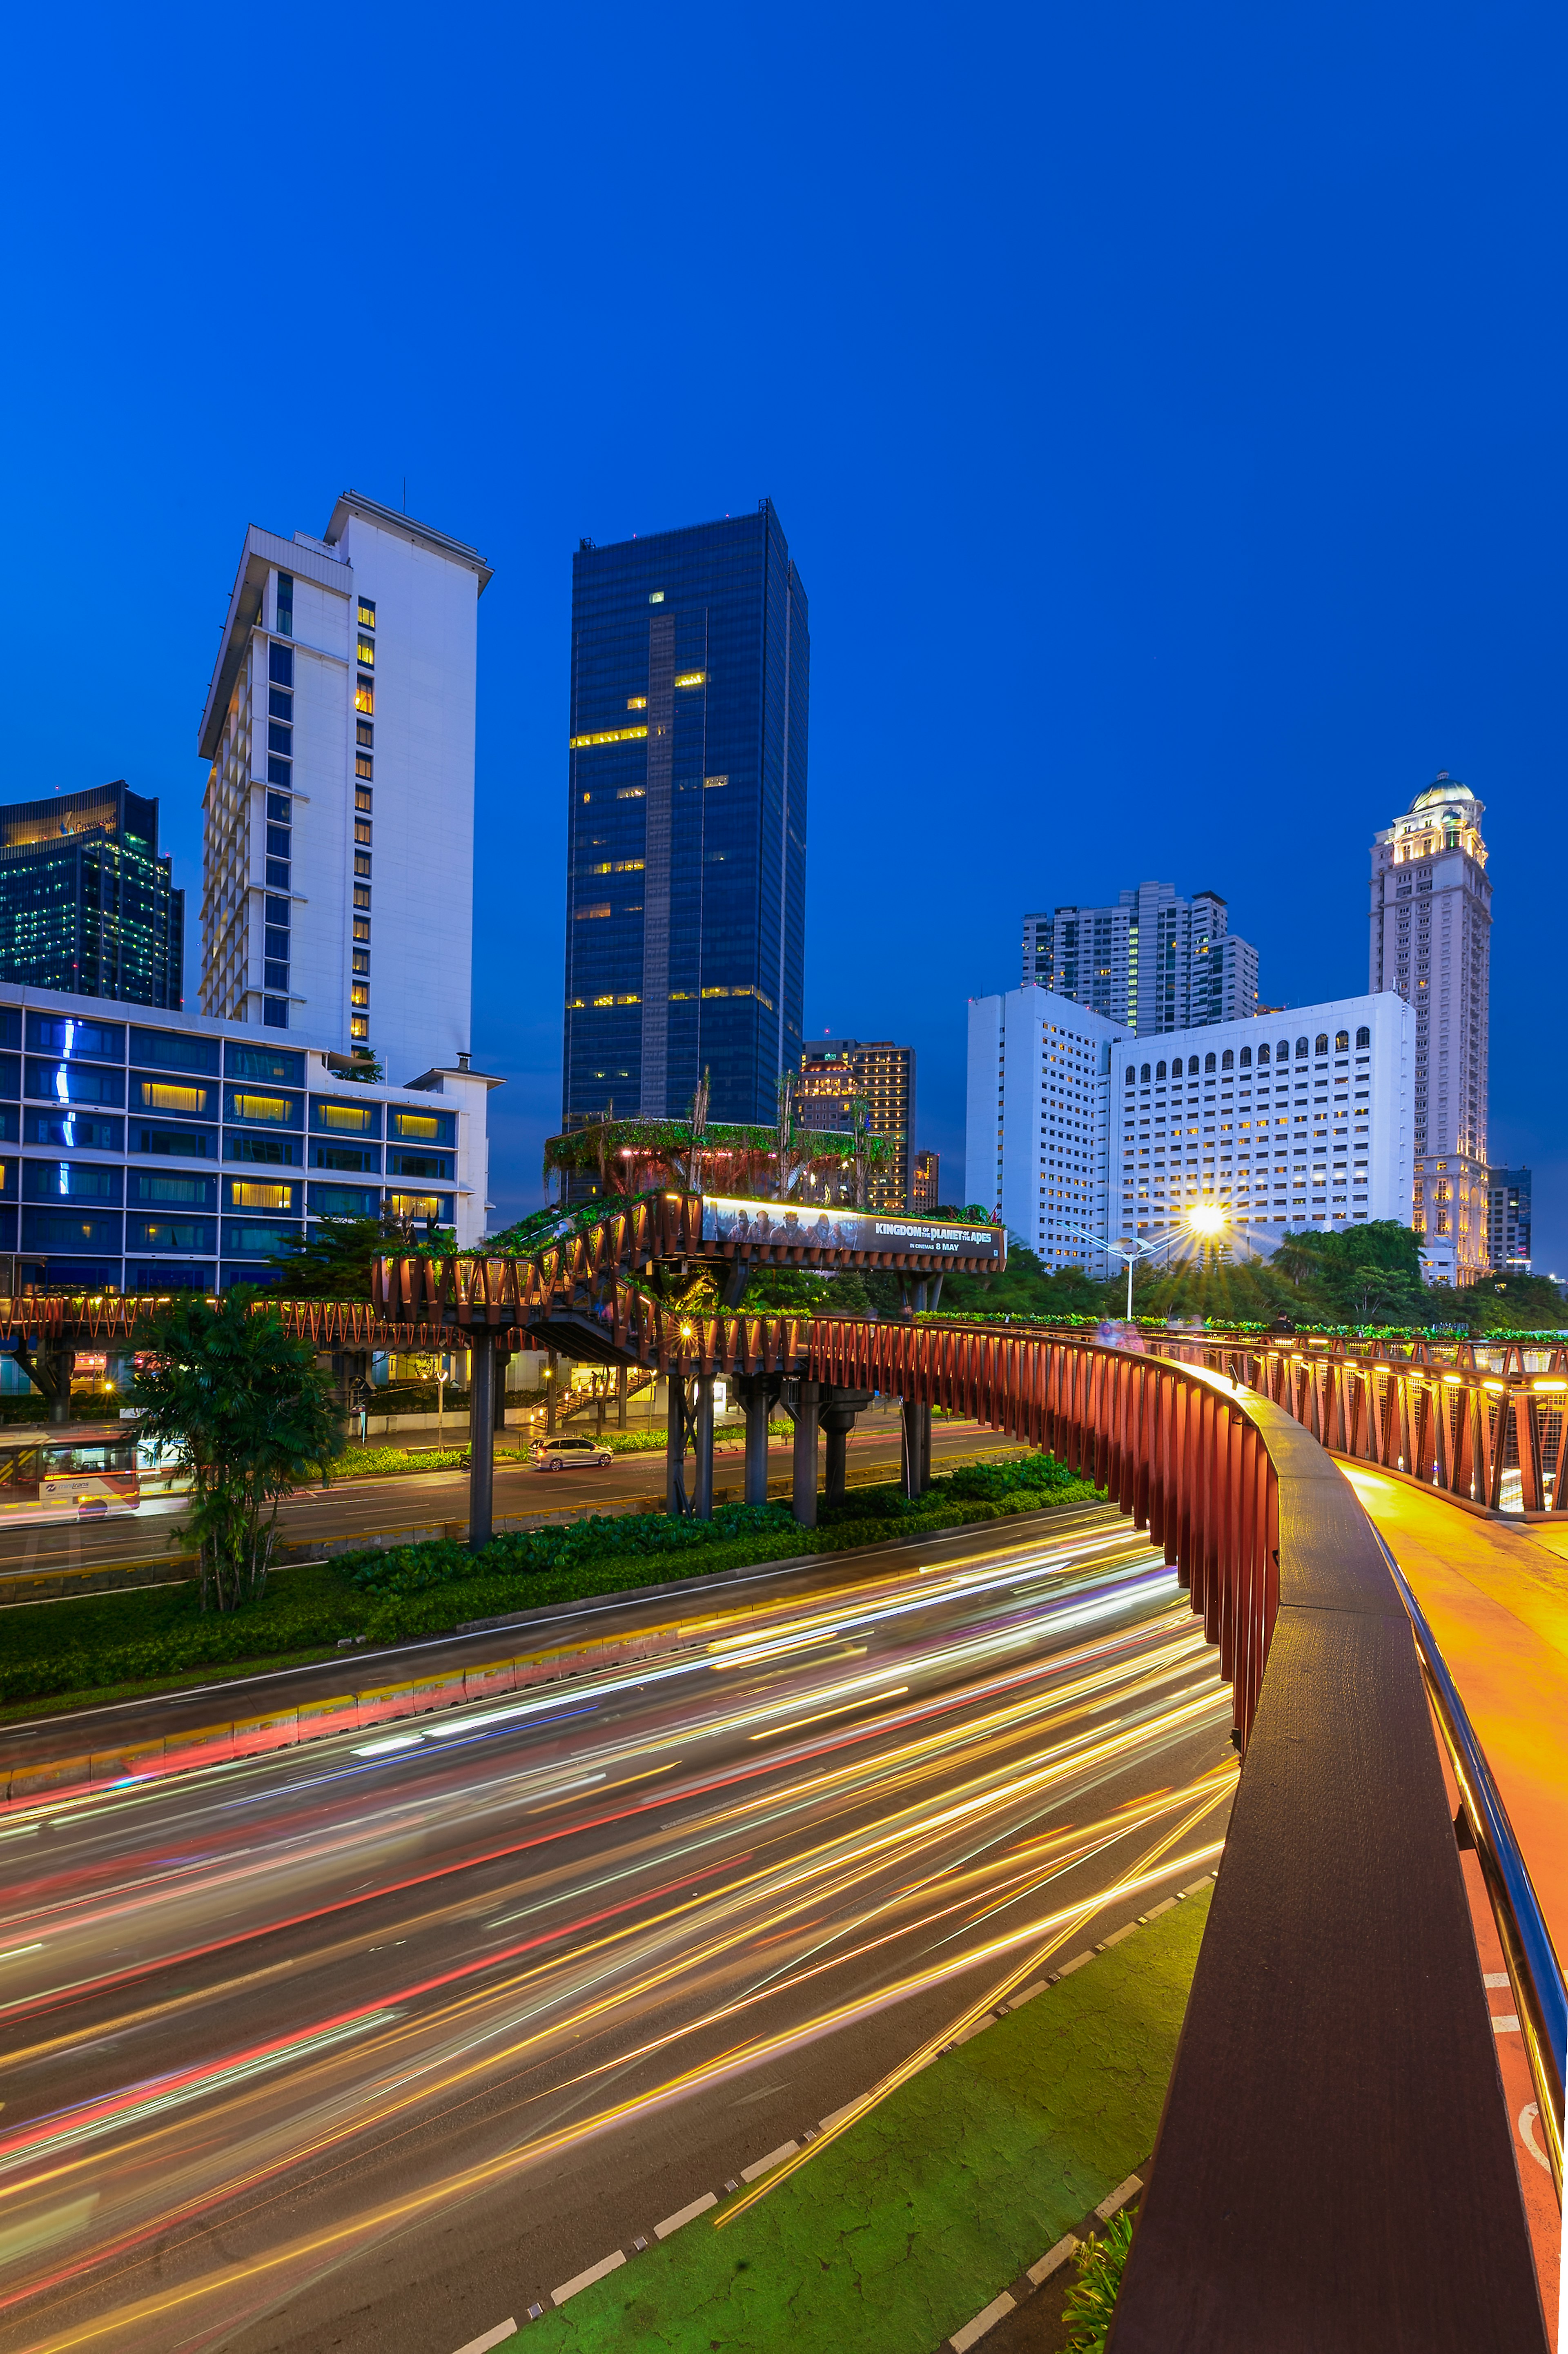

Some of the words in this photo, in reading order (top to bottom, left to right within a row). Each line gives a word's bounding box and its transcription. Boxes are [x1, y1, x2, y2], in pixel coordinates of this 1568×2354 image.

[875, 1223, 922, 1237] KINGDOM
[931, 1228, 963, 1240] PLANET
[971, 1232, 991, 1244] APES
[942, 1243, 959, 1251] MAY
